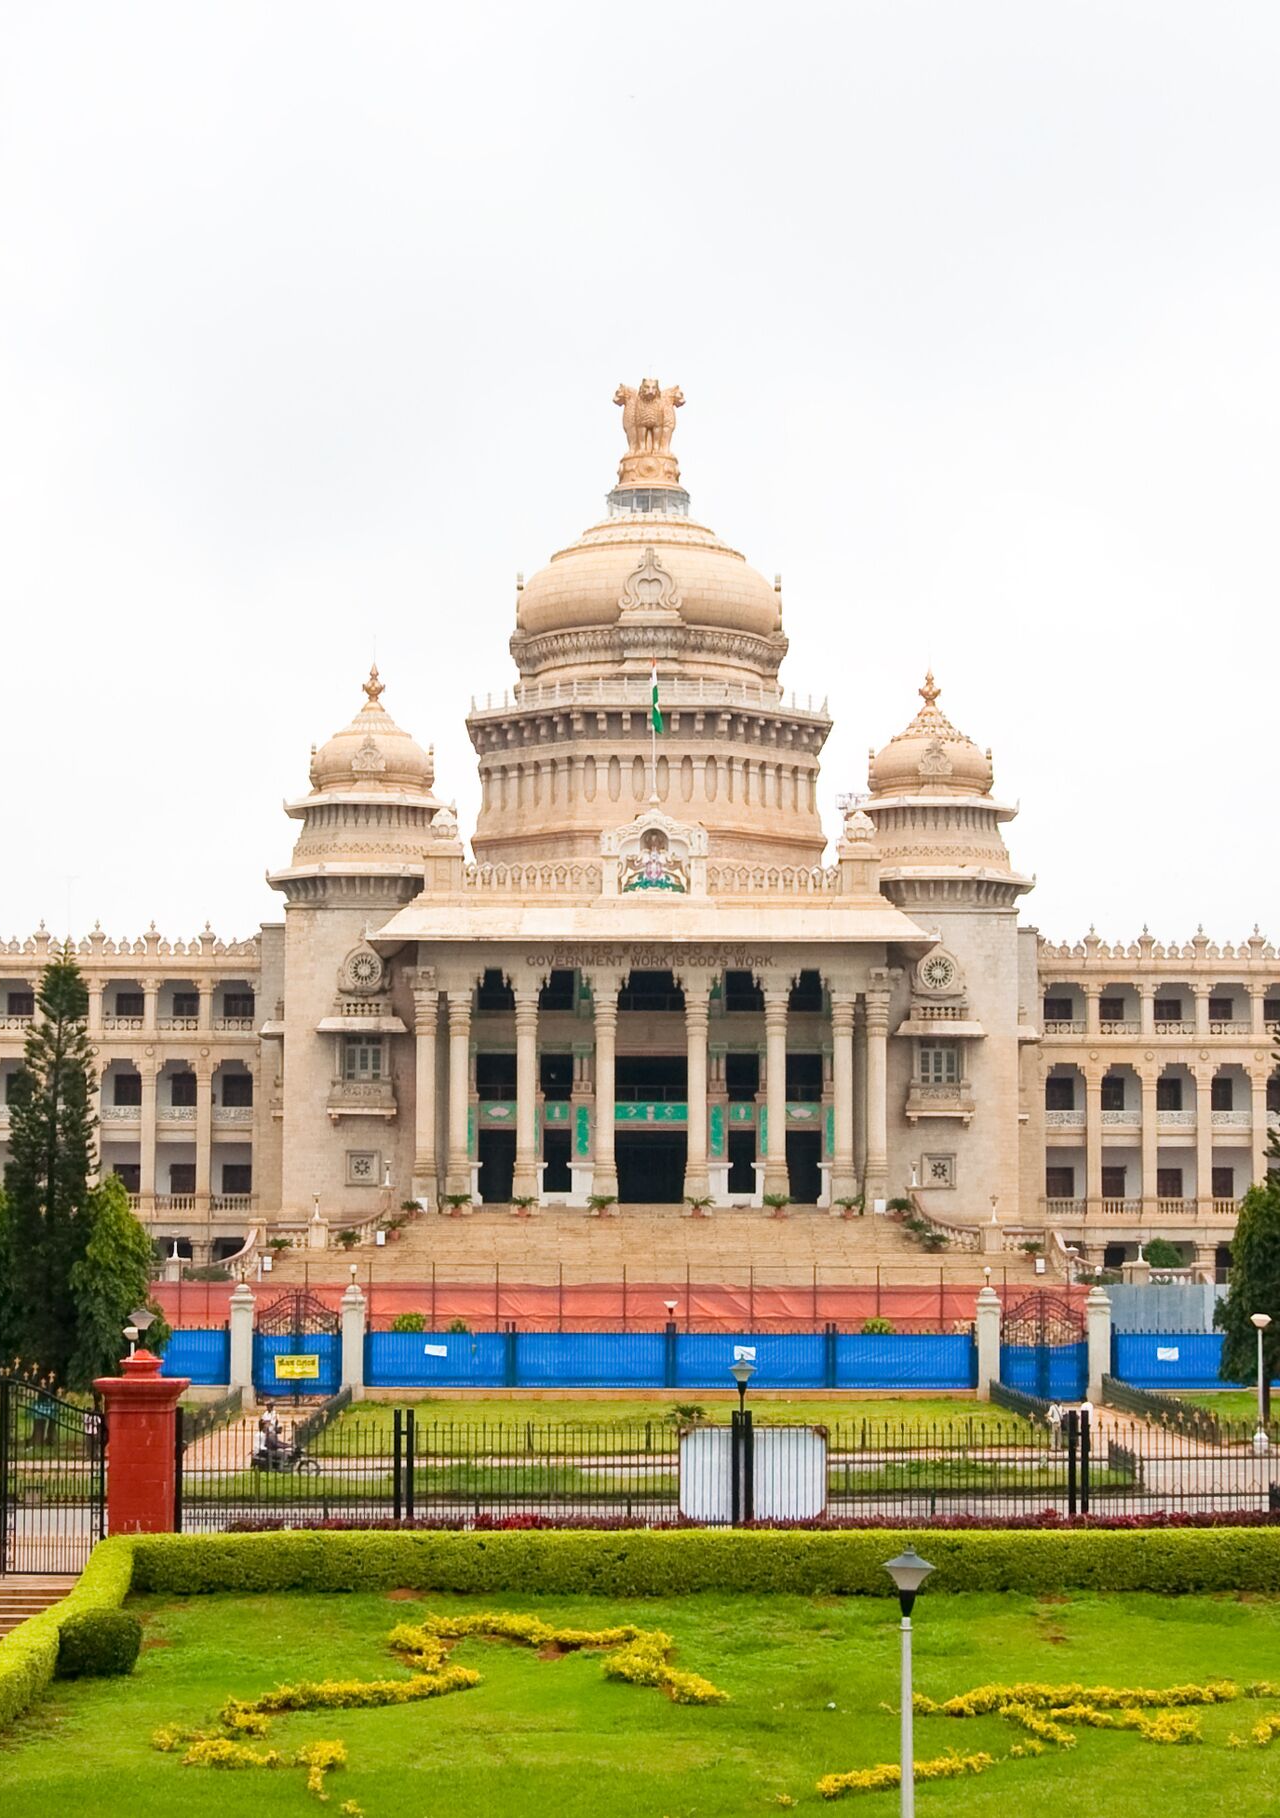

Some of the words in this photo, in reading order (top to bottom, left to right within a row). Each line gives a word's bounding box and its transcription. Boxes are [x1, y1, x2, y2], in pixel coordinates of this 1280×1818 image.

[526, 955, 625, 966] GOVERNMENT
[630, 955, 668, 966] WORK
[672, 955, 685, 966] IS
